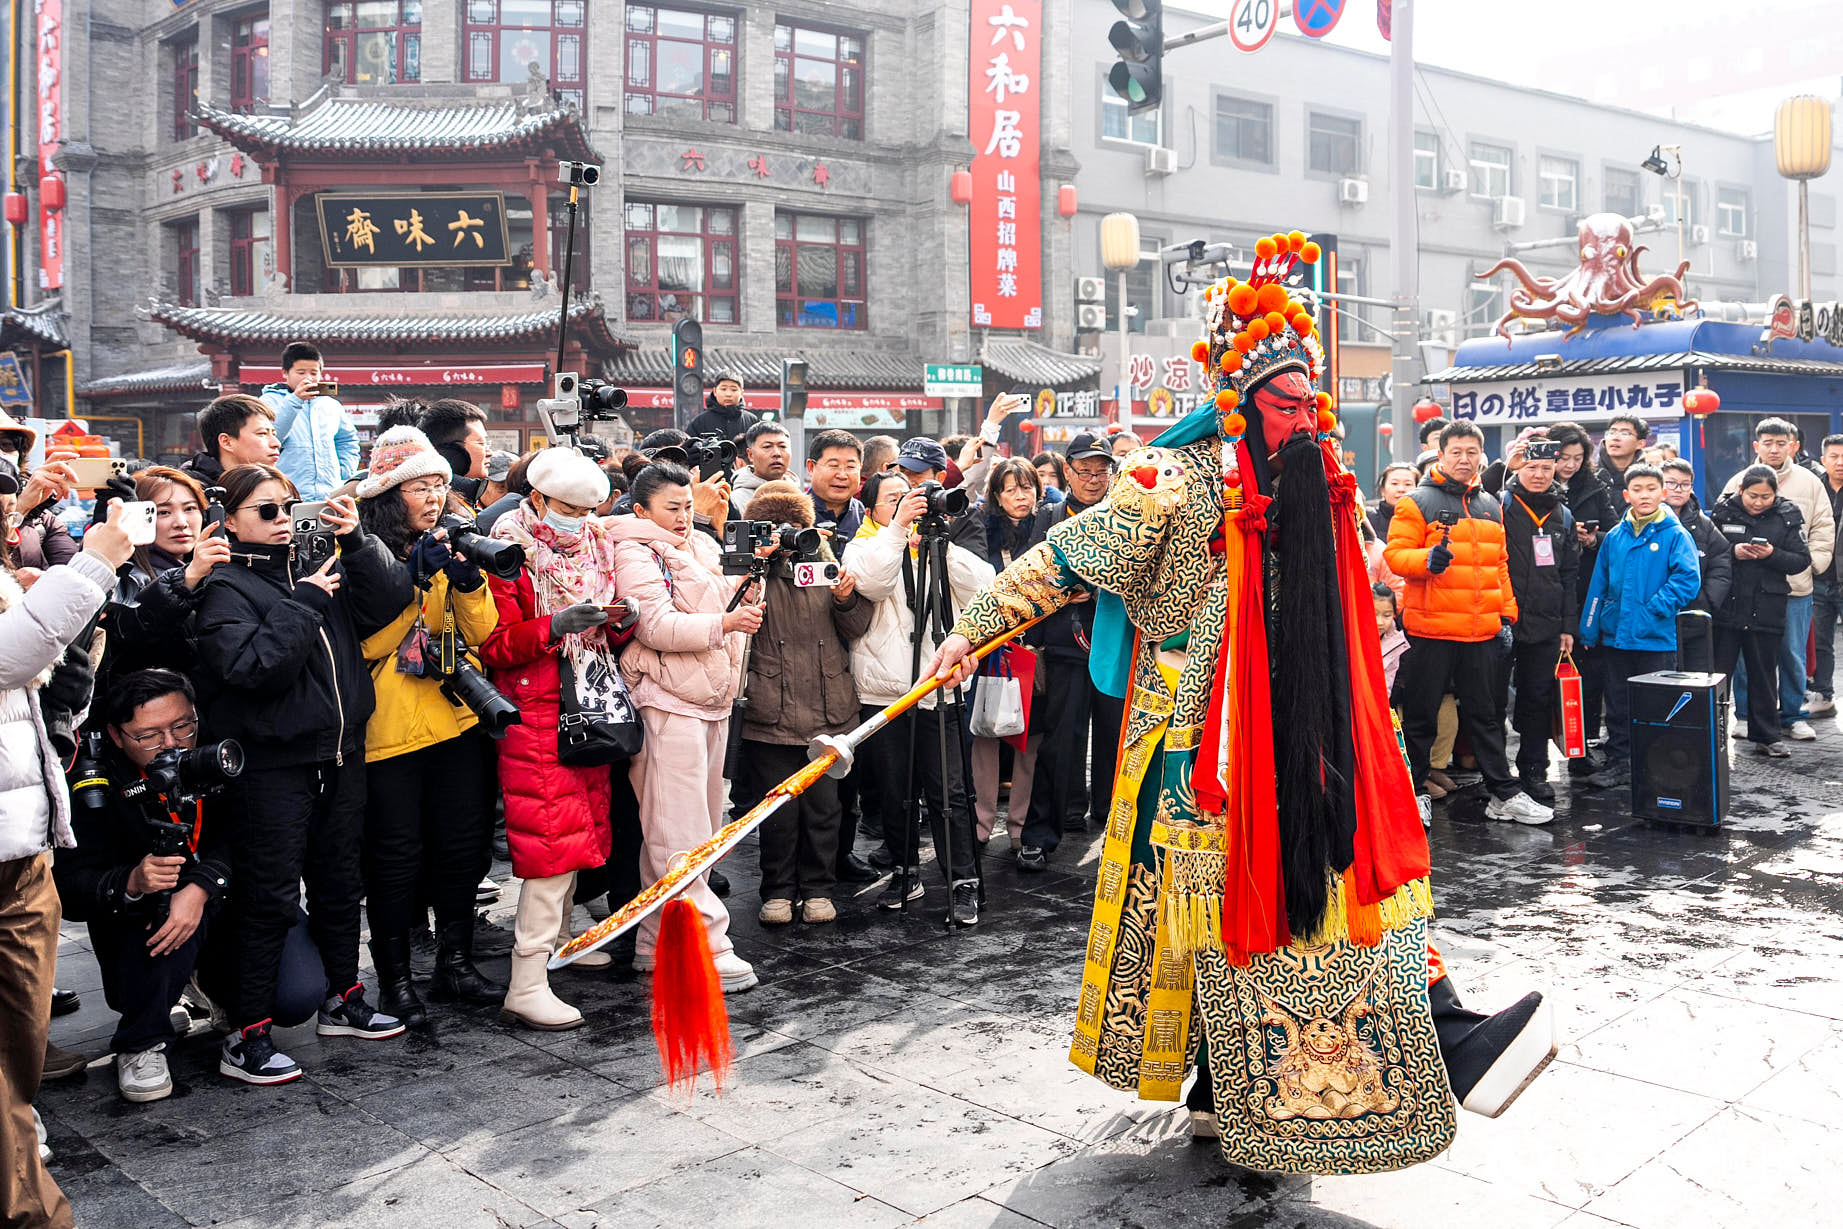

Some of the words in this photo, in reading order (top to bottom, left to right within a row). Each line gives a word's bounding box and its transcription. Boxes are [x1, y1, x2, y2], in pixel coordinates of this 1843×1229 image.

[1238, 0, 1269, 32] 40
[984, 4, 1029, 158] 六和居
[997, 169, 1017, 297] 山西招牌菜
[1129, 354, 1209, 391] 炒凉
[1546, 382, 1682, 413] 章鱼小丸子
